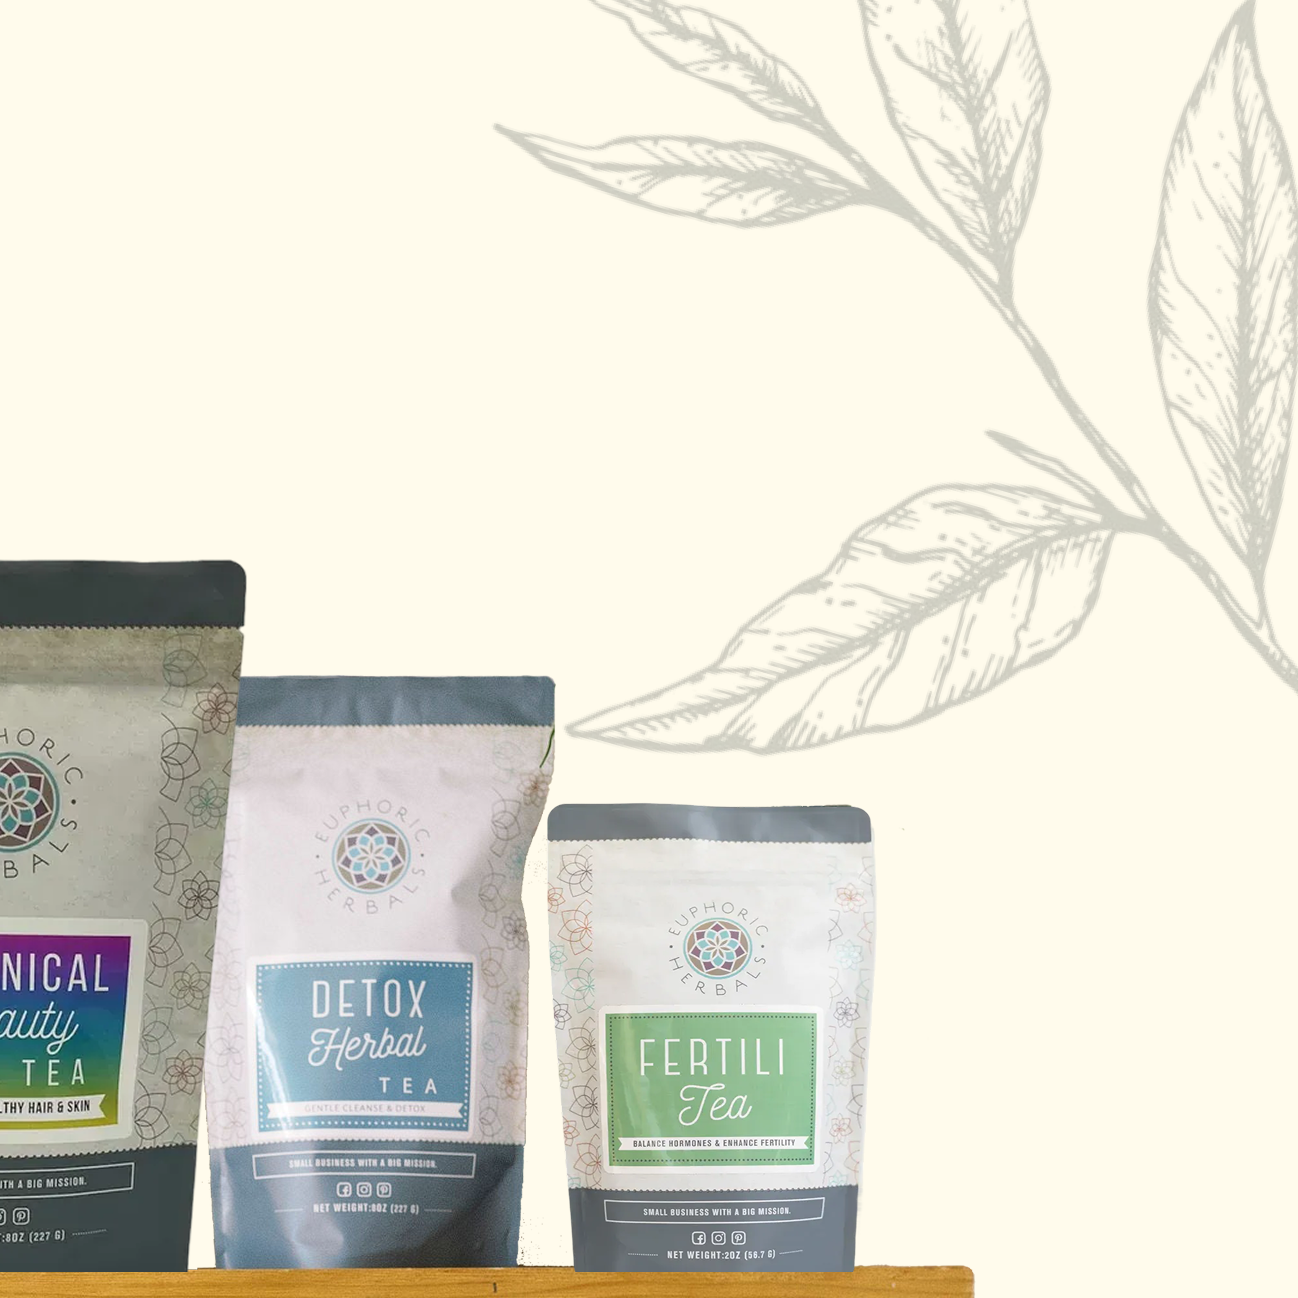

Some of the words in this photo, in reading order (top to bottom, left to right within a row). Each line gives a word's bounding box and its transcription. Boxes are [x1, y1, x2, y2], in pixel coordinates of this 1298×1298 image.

[314, 800, 430, 842] EUPHORIC
[314, 868, 425, 914] HERBALS
[668, 902, 768, 936] EUPHORIC
[669, 957, 766, 995] HERBALS
[312, 979, 426, 1018] DETOX
[308, 1025, 427, 1071] Herbal
[640, 1038, 783, 1076] FERTILI
[22, 1059, 85, 1086] TEA
[379, 1077, 437, 1094] TEA
[29, 1102, 53, 1113] HAIR
[57, 1101, 63, 1112] &
[68, 1100, 90, 1112] SKIN
[305, 1104, 339, 1112] GENTLE
[396, 1105, 426, 1113] DETOX
[678, 1083, 753, 1126] Tea
[715, 1139, 720, 1147] &
[289, 1159, 313, 1168] SMALL
[315, 1159, 355, 1167] BUSINESS
[358, 1159, 377, 1167] WITH
[380, 1159, 385, 1167] A
[388, 1159, 401, 1167] BIG
[404, 1159, 437, 1168] MISSION.
[18, 1180, 23, 1188] A
[27, 1180, 42, 1188] BIG
[47, 1177, 87, 1187] MISSION.
[313, 1204, 329, 1212] NET
[391, 1204, 407, 1213] (227
[712, 1208, 732, 1216] WITH
[758, 1207, 791, 1215] MISSION.
[29, 1231, 50, 1243] (227
[54, 1230, 65, 1241] G)
[667, 1251, 683, 1259] NET
[744, 1251, 764, 1260] (56.7
[767, 1250, 775, 1259] G)
